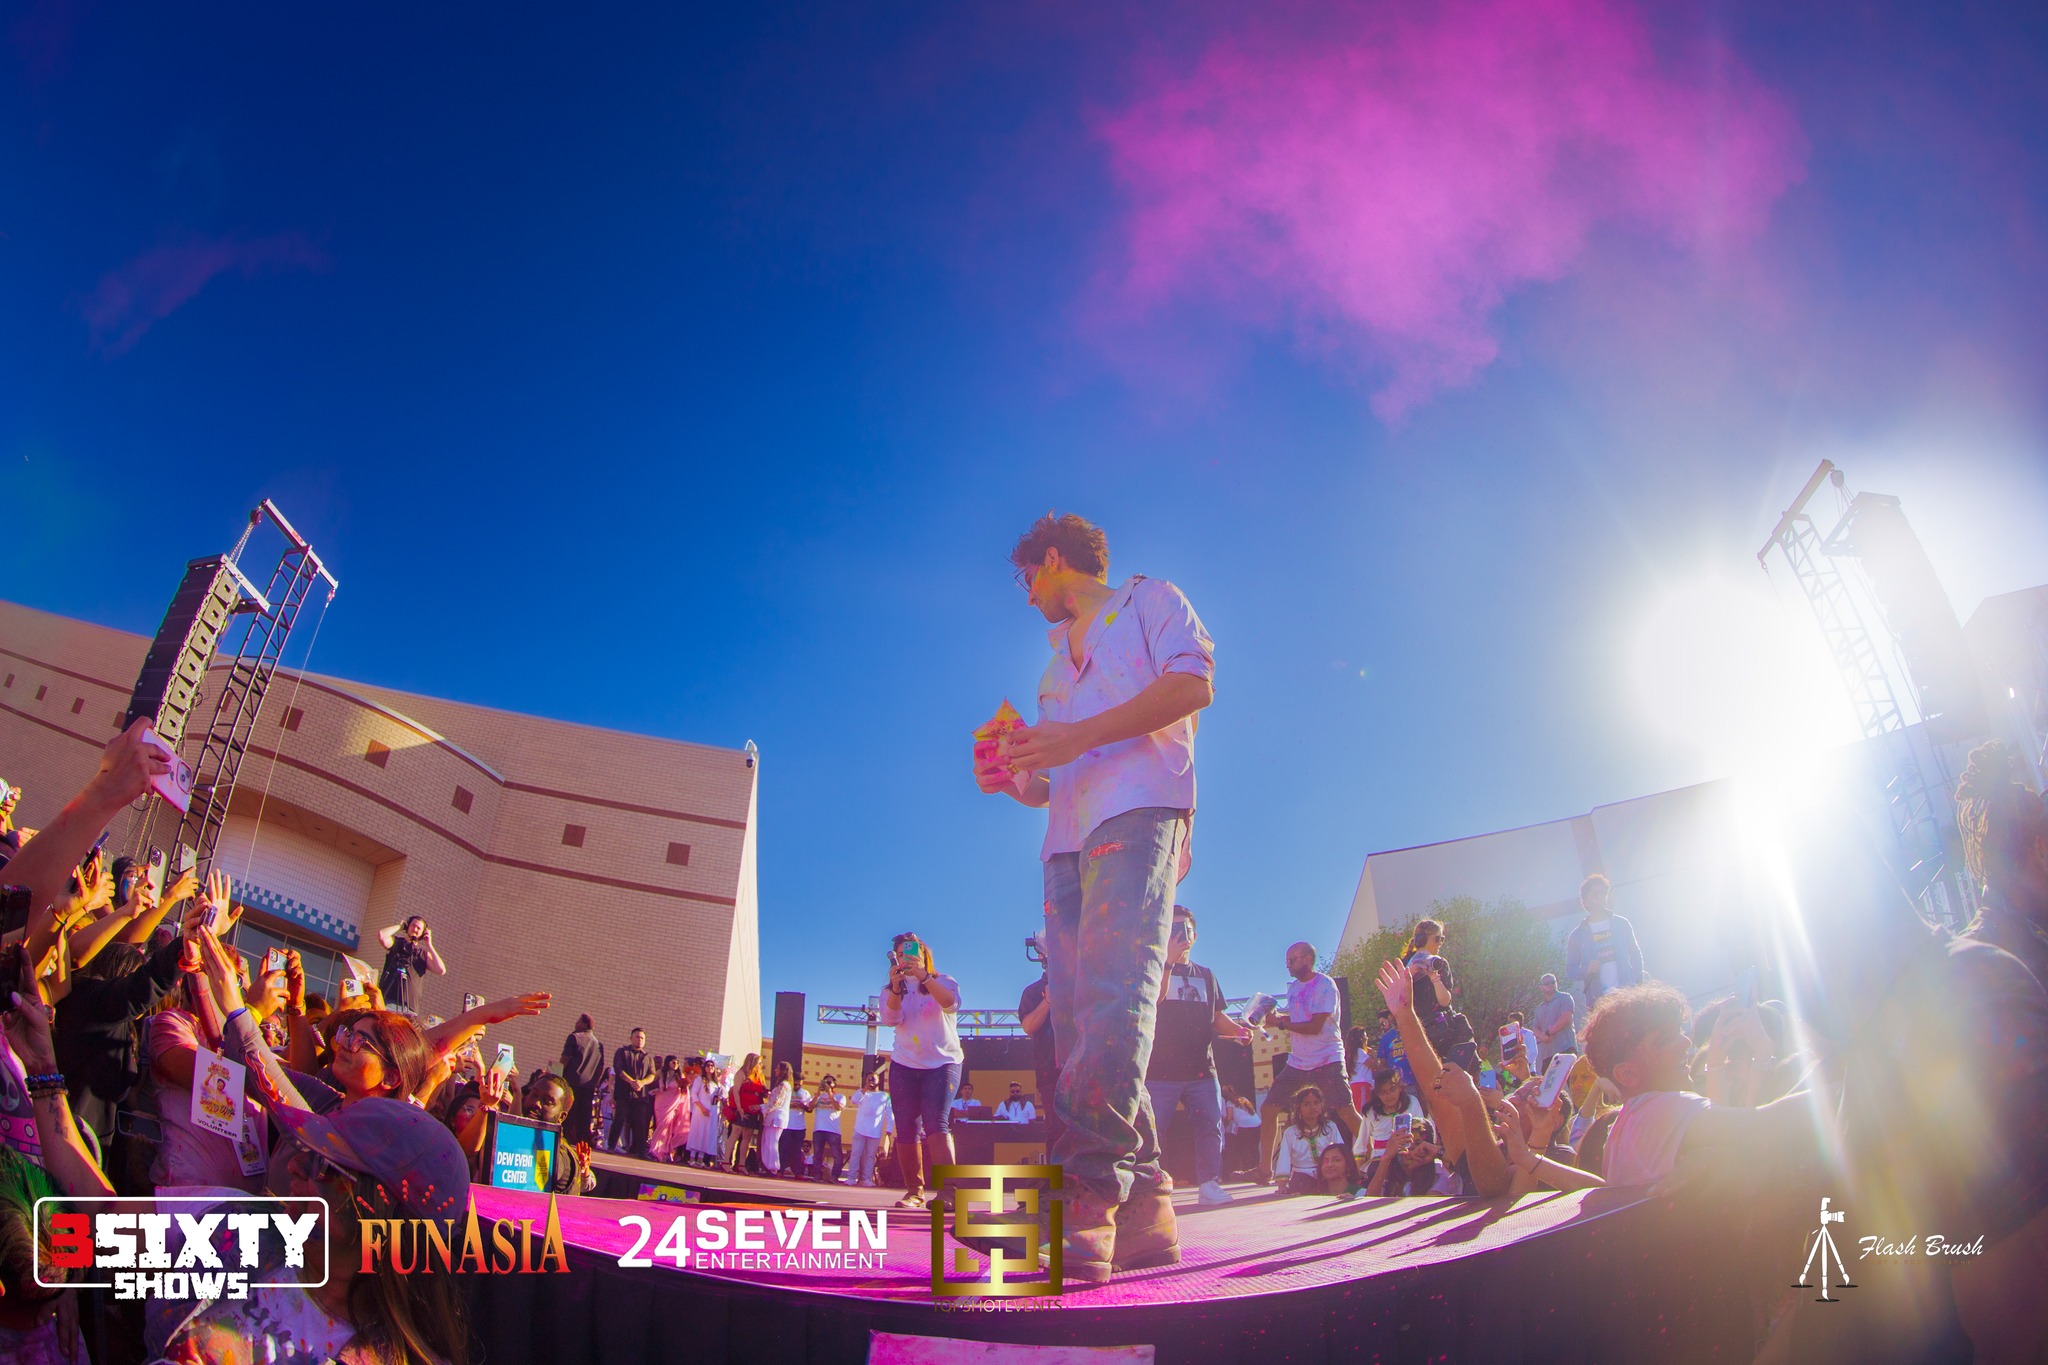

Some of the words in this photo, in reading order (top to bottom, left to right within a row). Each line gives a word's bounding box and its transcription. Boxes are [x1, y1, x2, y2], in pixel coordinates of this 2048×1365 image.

[198, 1118, 238, 1138] VOLUNTEER
[497, 1151, 514, 1166] DEW
[514, 1153, 533, 1168] EVENT
[502, 1169, 527, 1184] CENTER
